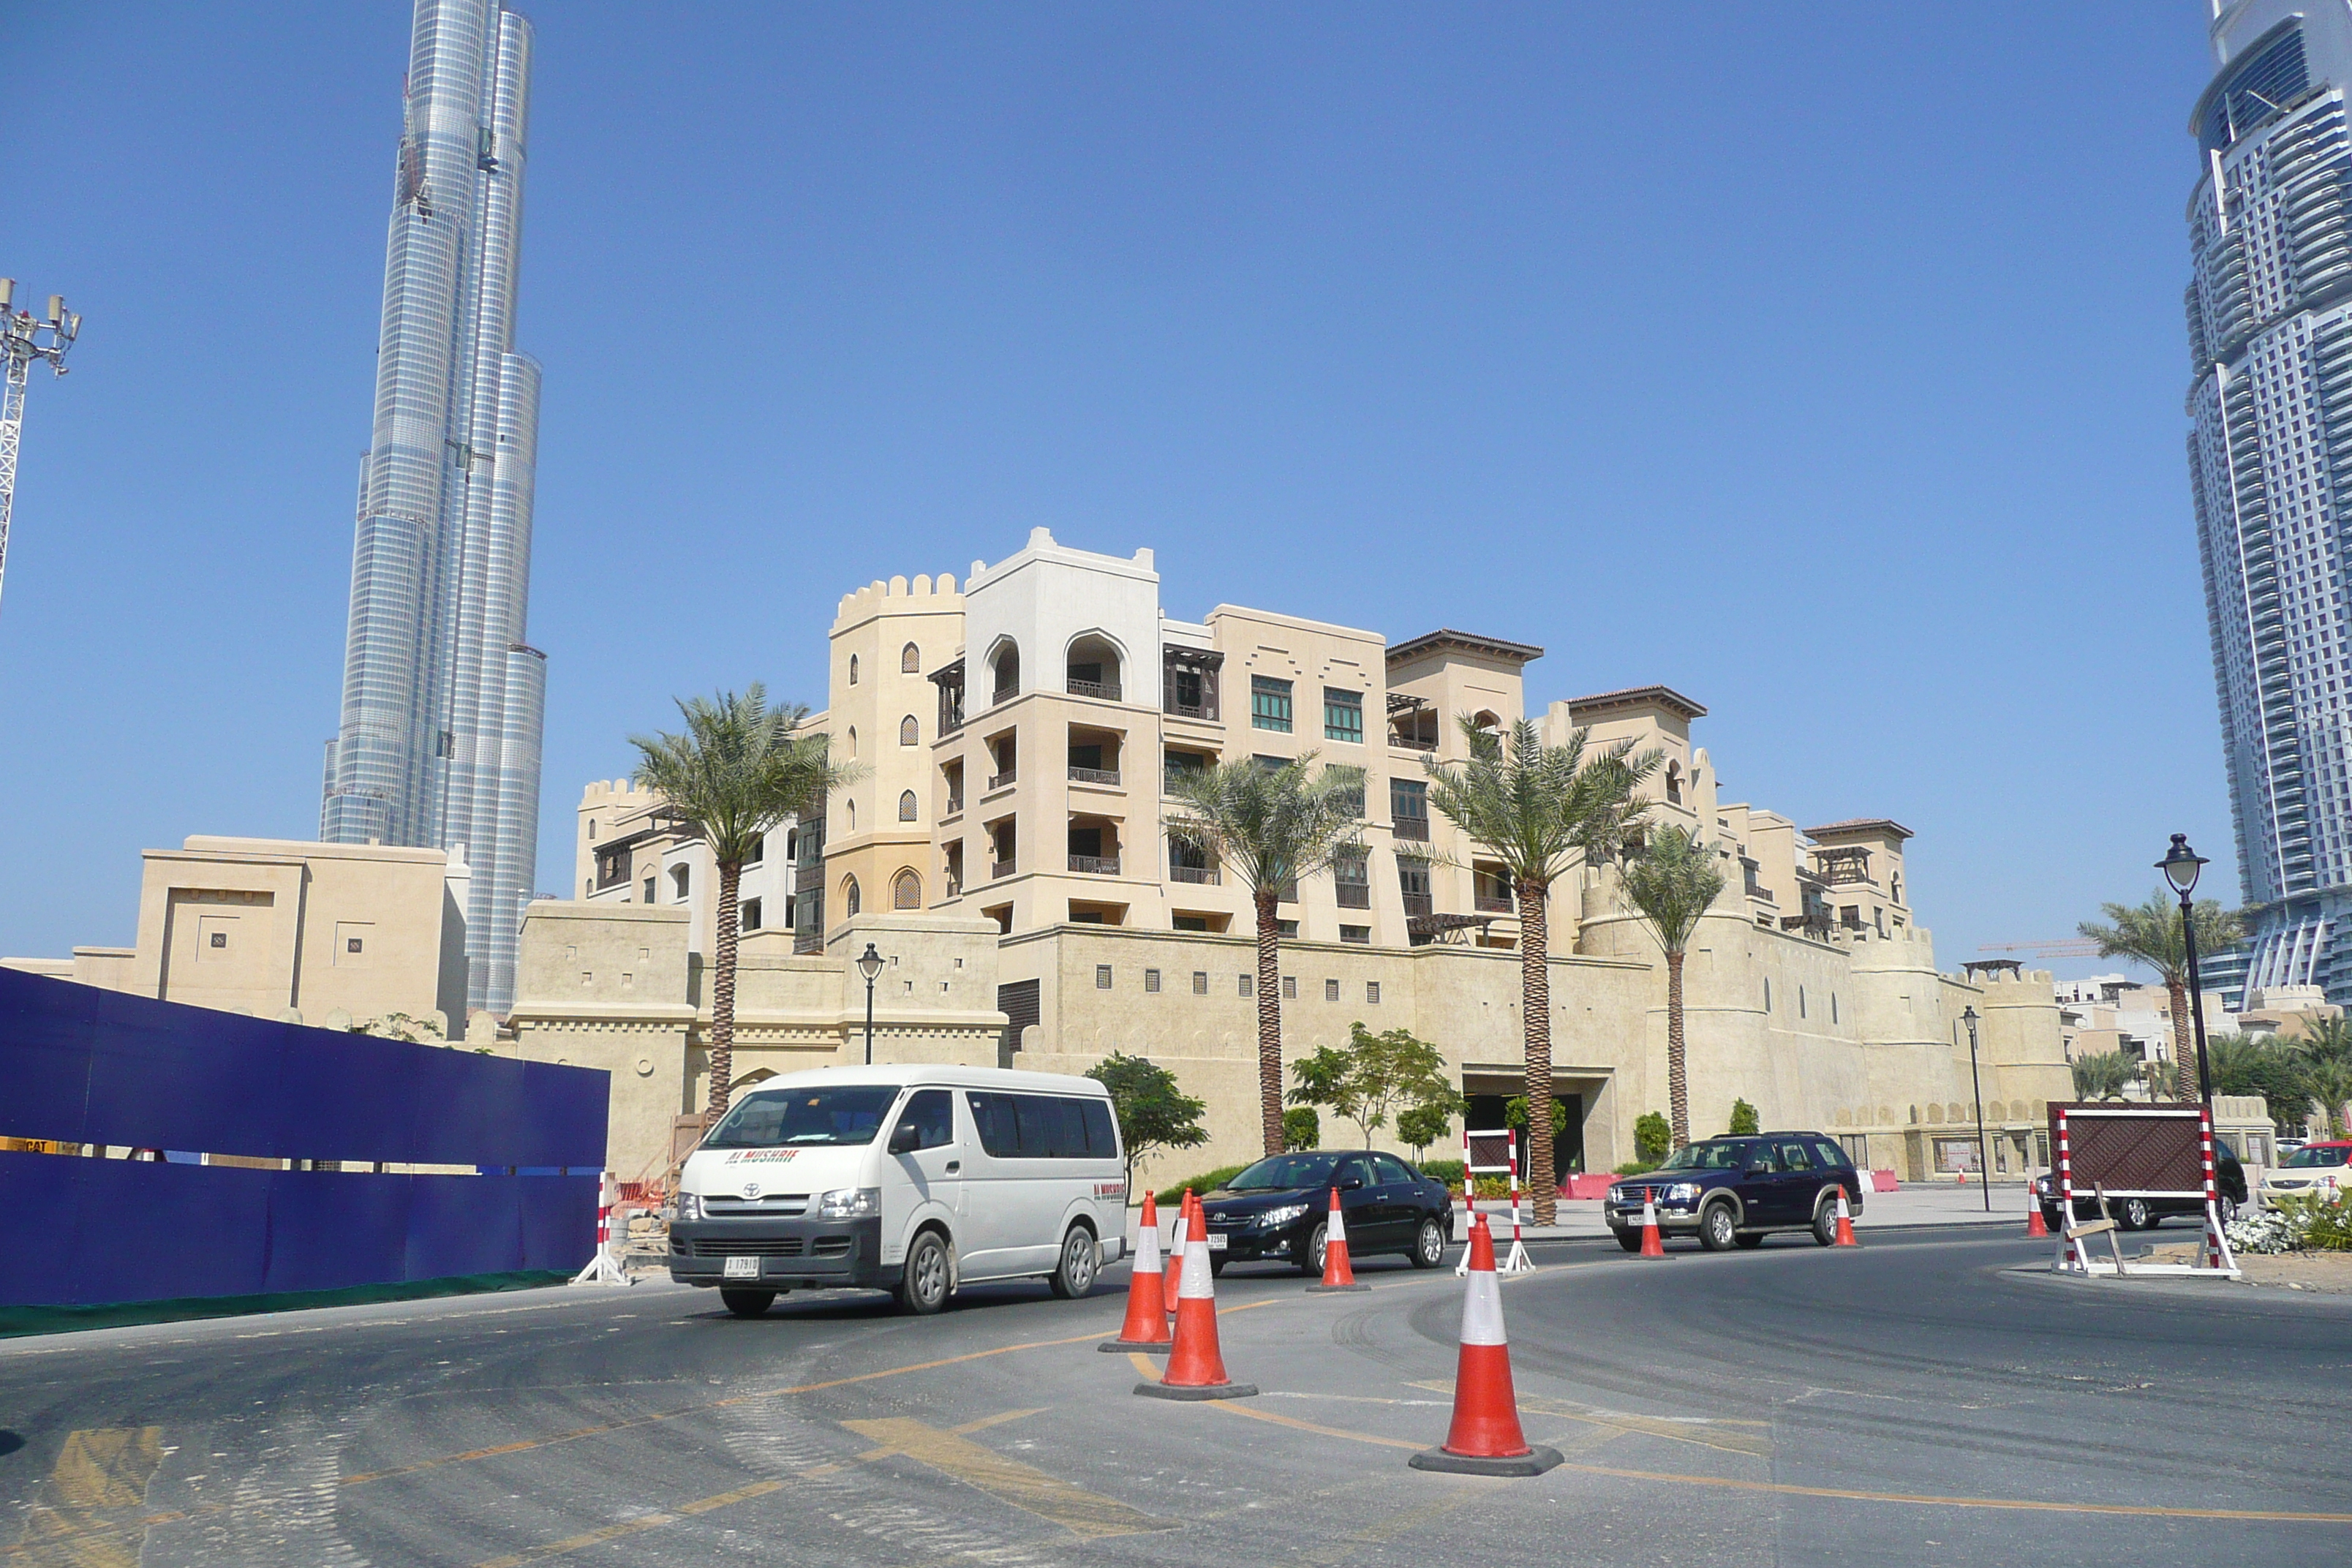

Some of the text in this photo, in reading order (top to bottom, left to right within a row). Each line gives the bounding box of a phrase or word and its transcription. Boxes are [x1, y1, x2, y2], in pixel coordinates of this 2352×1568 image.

[26, 1141, 47, 1153] CAT
[725, 1150, 801, 1165] AL MUSHRIF
